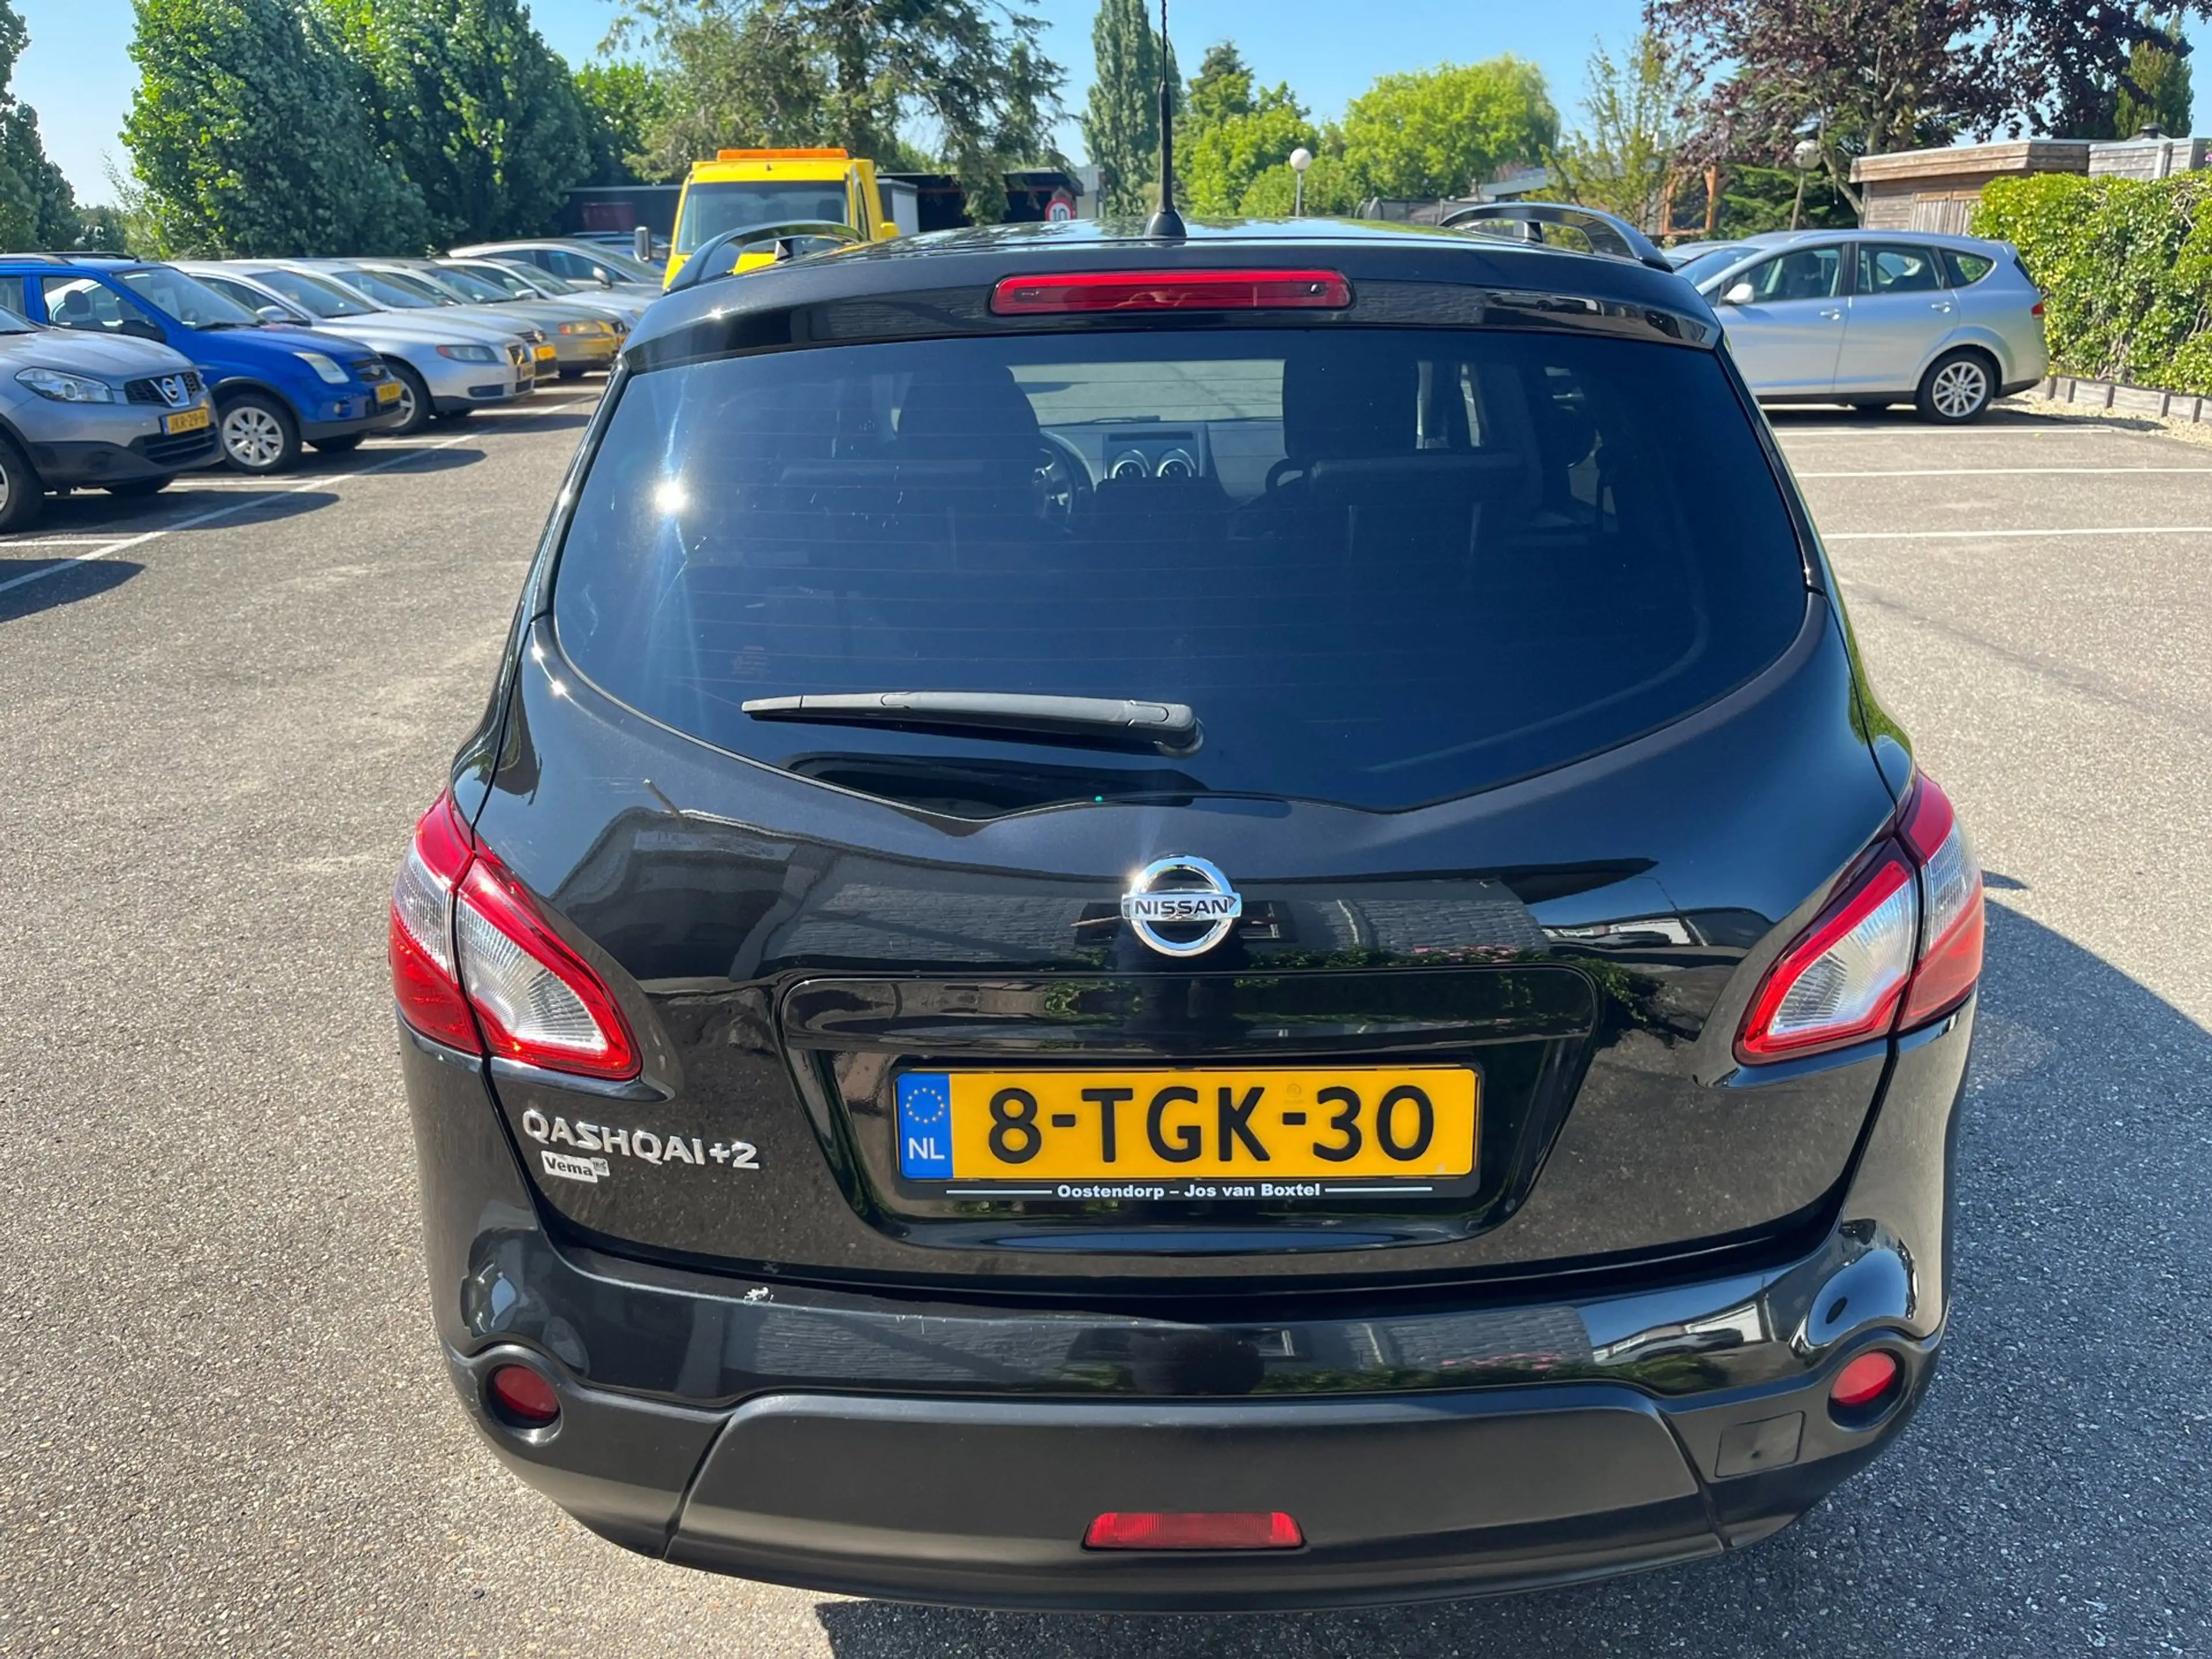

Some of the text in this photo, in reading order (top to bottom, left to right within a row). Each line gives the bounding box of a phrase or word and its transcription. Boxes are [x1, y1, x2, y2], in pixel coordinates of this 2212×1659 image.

[1053, 208, 1068, 221] 10
[1134, 900, 1229, 916] NISSAN
[988, 1085, 1434, 1164] 8-TGK-30
[522, 1109, 760, 1170] QASHQAI+2
[908, 1137, 945, 1160] NL
[544, 1156, 593, 1176] Vema
[1057, 1184, 1165, 1200] Oostendorp
[1184, 1185, 1217, 1198] Jos
[1222, 1187, 1255, 1197] van
[1261, 1183, 1320, 1197] Boxtel
